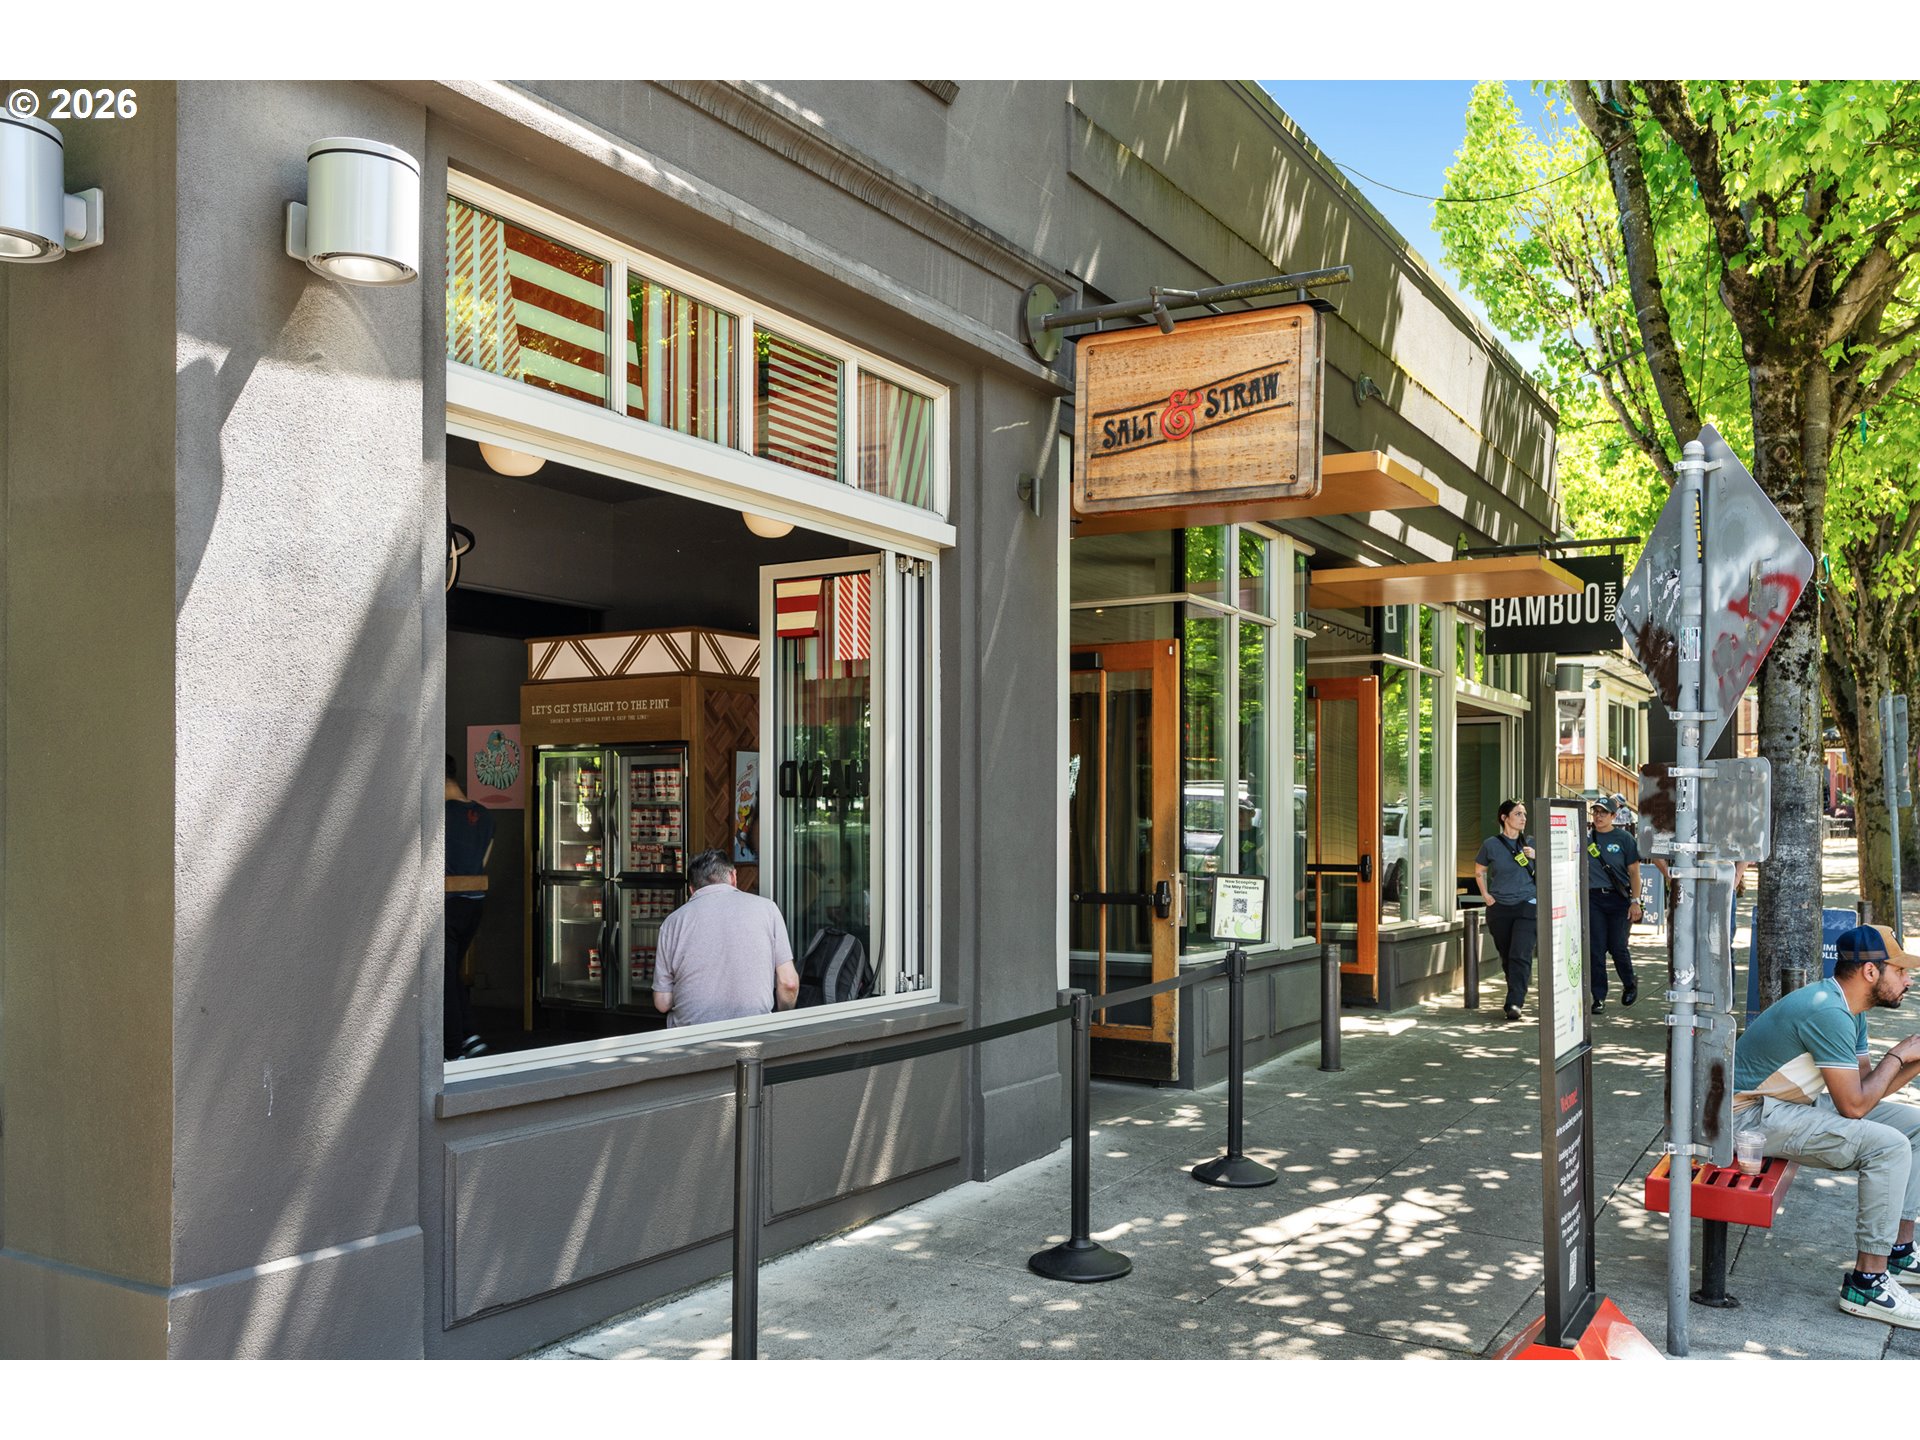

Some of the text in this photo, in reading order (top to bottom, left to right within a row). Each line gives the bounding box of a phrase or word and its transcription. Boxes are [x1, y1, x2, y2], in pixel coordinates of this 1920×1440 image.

[1102, 371, 1281, 449] SALT & STRAW
[1490, 582, 1600, 628] BAMBOO
[1603, 581, 1617, 623] SUSHI
[532, 699, 669, 715] LET'S GET STRAIGHT TO THE PINT
[1644, 911, 1658, 923] COLD
